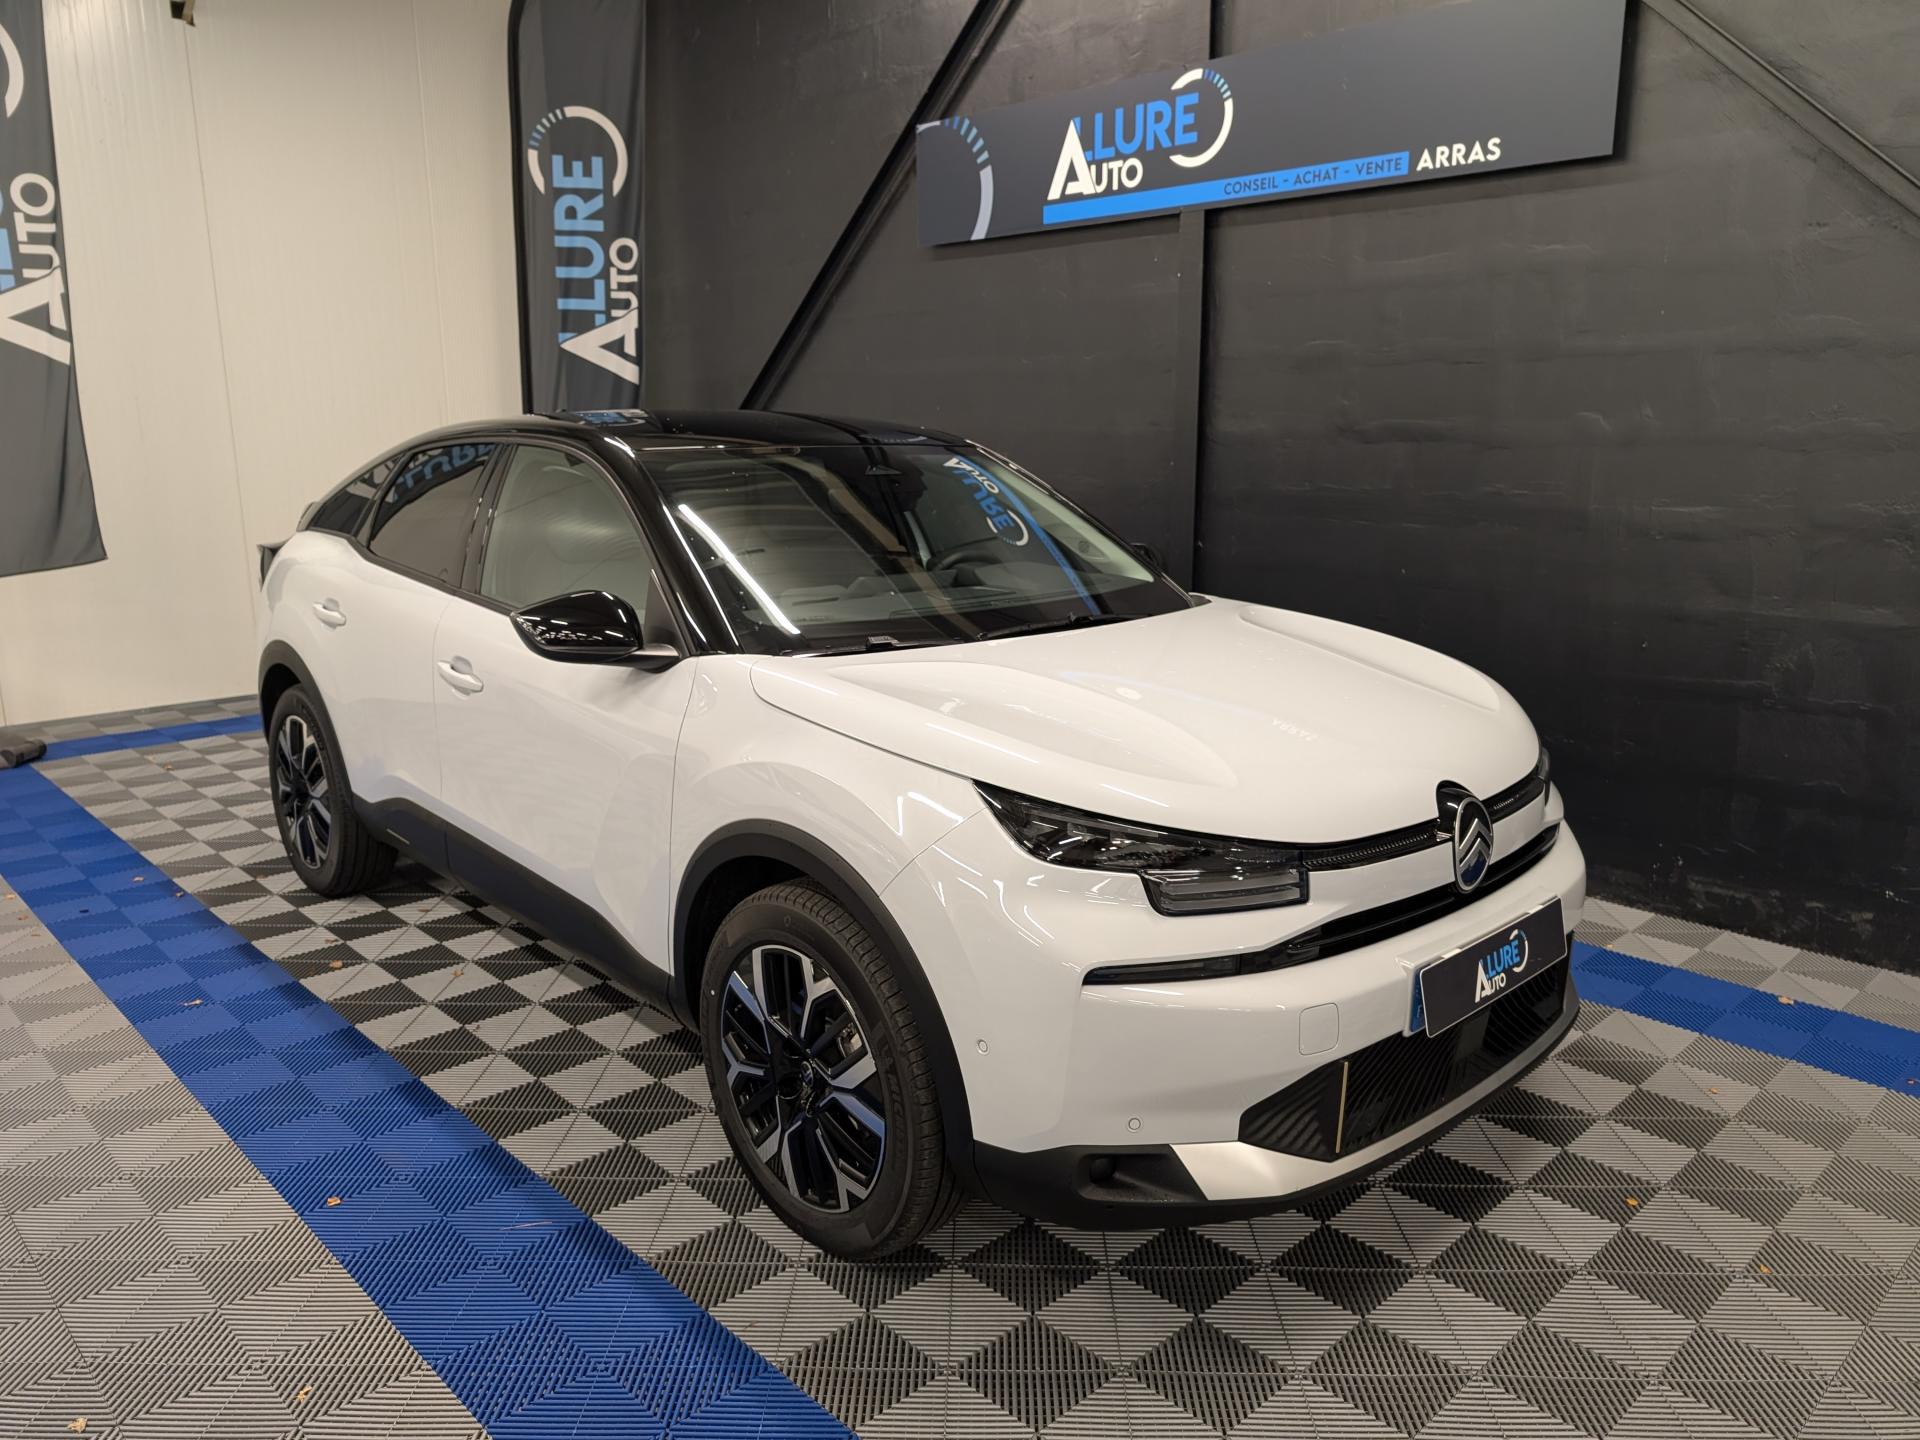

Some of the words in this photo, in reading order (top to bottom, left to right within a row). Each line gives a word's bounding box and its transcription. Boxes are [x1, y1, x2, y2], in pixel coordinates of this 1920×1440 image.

[1047, 119, 1144, 200] AUTO
[1223, 175, 1279, 196] CONSEIL
[1293, 167, 1340, 186] ACHAT
[1355, 157, 1402, 177] VENTE
[1416, 137, 1501, 171] ARRAS
[0, 172, 71, 366] AUTO
[560, 237, 640, 385] AUTO
[1475, 960, 1507, 1003] AUTO
